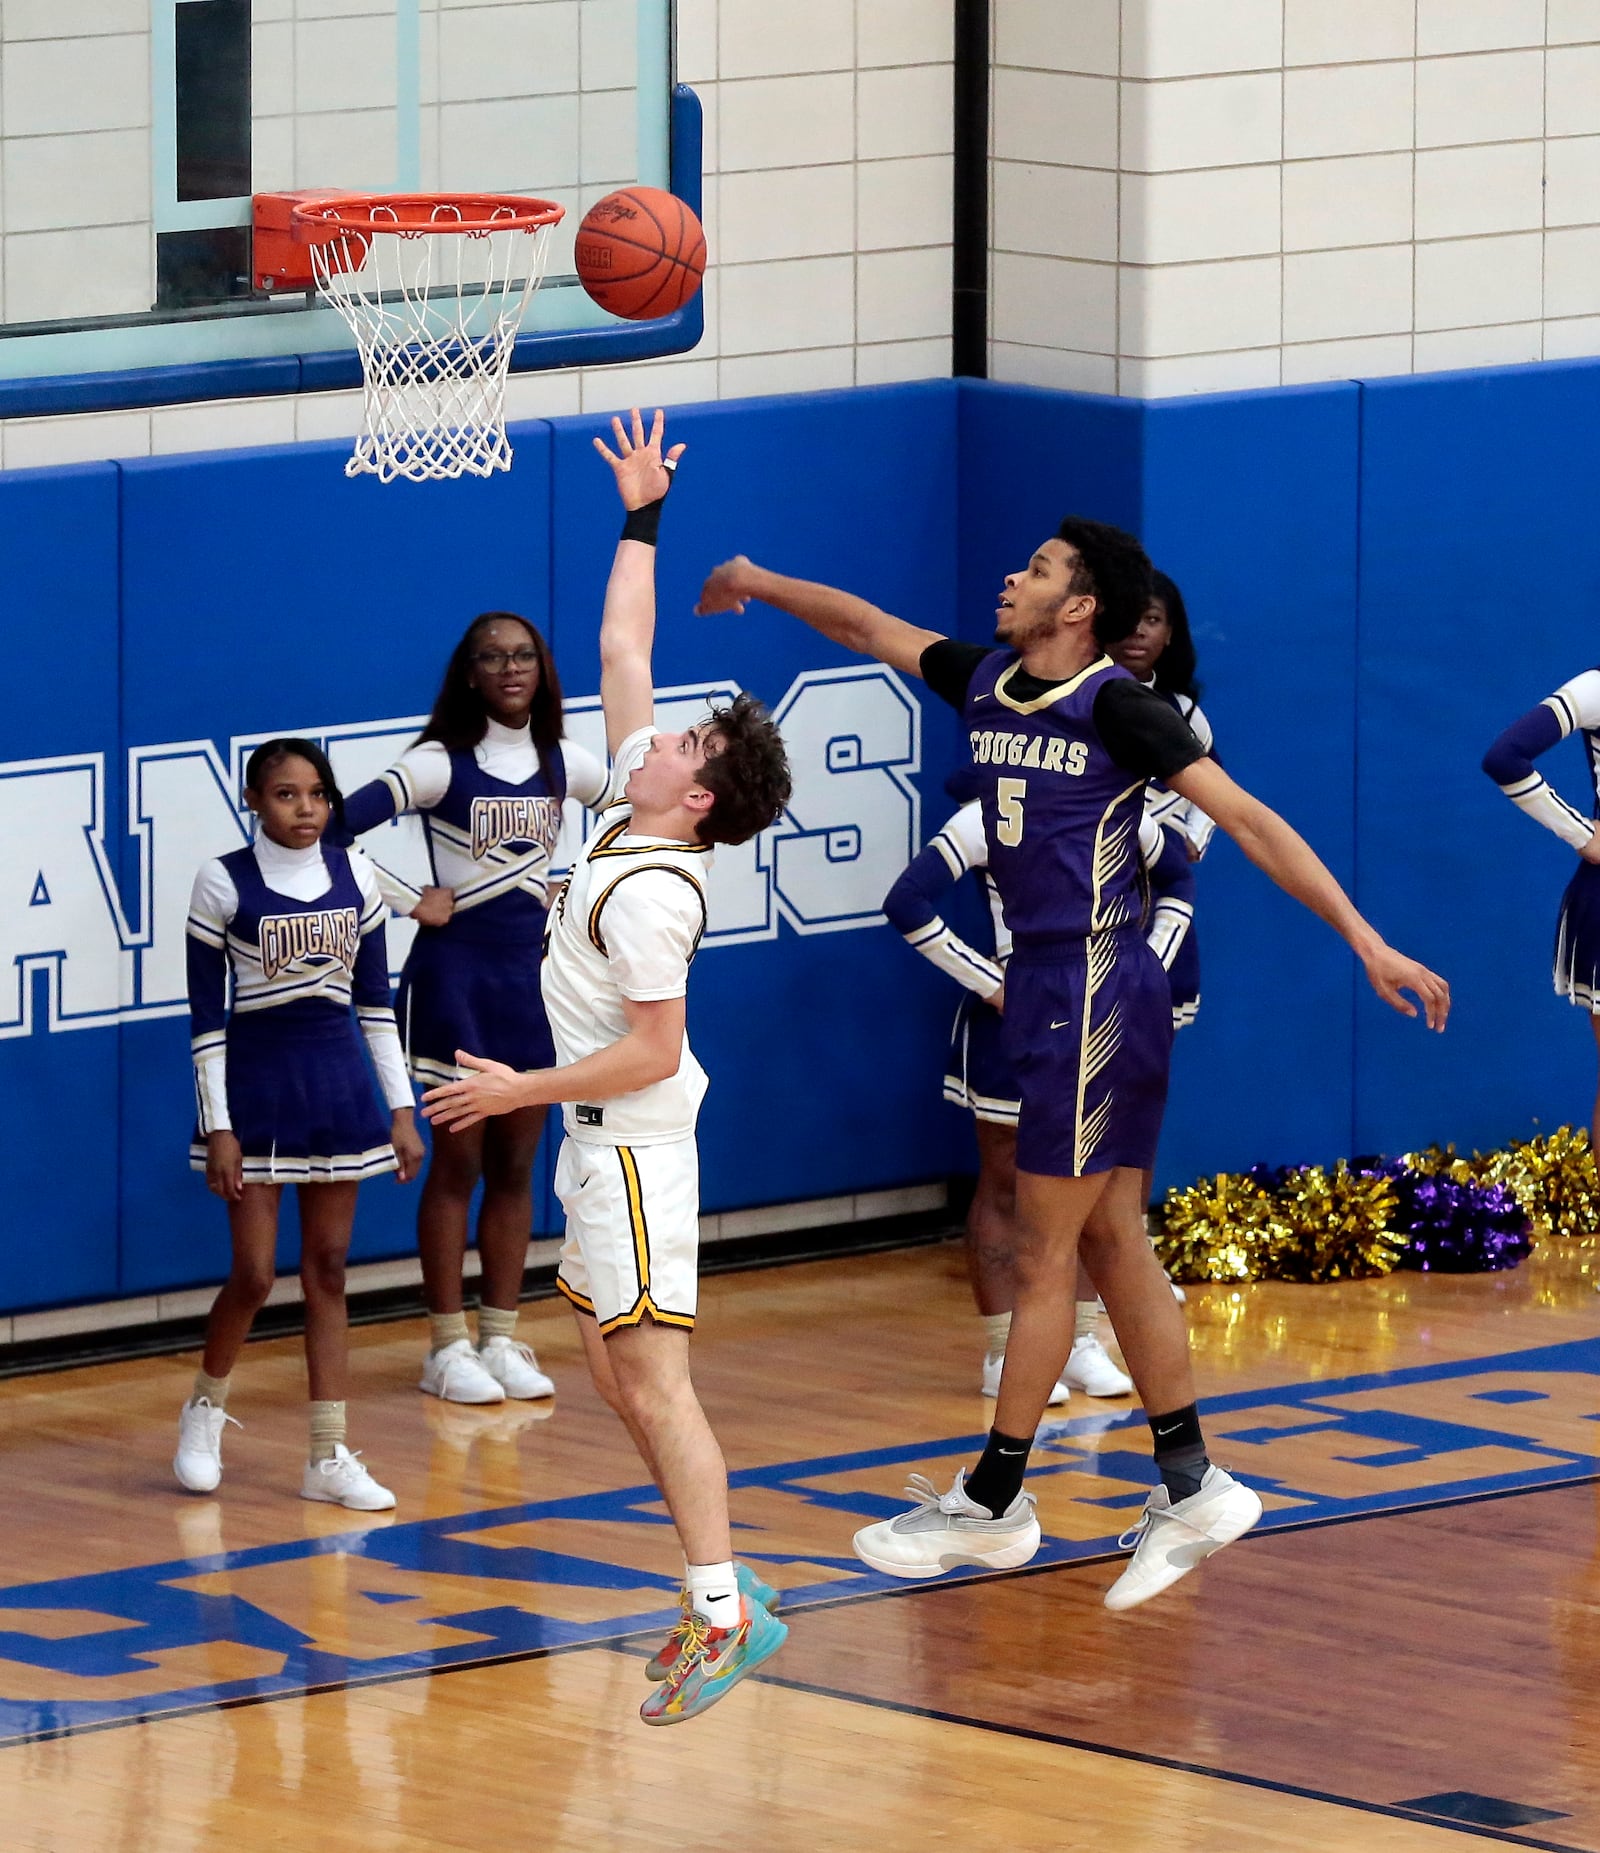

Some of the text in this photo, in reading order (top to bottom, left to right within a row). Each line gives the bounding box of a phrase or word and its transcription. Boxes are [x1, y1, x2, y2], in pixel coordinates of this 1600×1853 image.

[970, 731, 1089, 776] COUGARS
[471, 797, 562, 861] COUGARS
[996, 777, 1027, 848] 5
[259, 907, 359, 980] COUGARS
